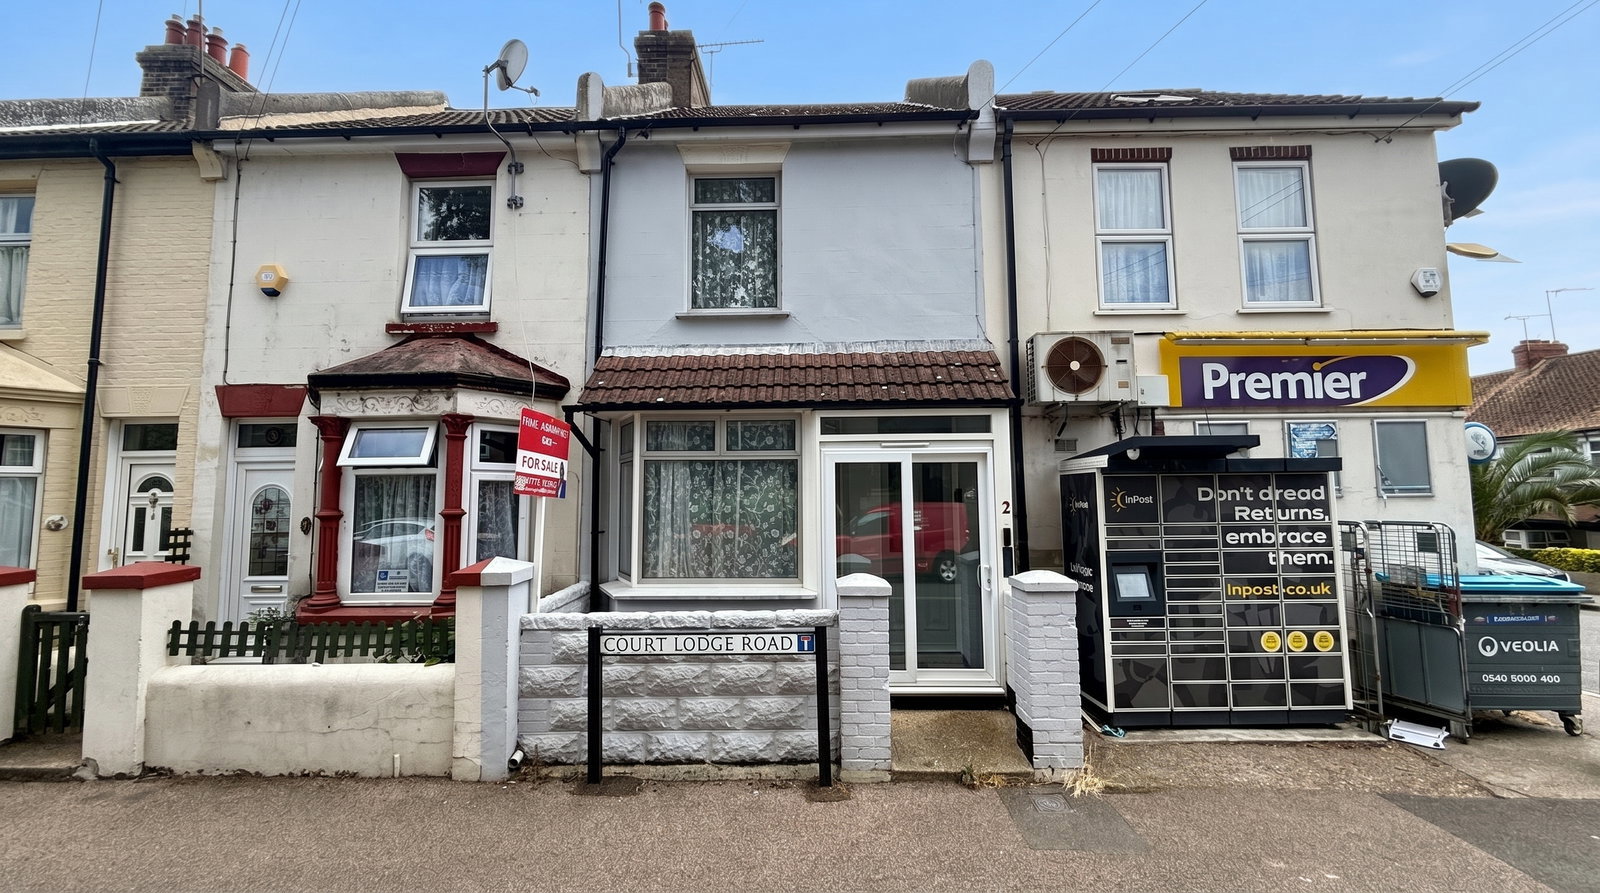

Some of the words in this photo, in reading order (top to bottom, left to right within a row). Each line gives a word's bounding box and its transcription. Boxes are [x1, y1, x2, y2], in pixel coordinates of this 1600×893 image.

[1202, 361, 1367, 400] Premier
[522, 455, 540, 470] FOR
[541, 459, 558, 473] SALE
[1125, 495, 1153, 504] InPost
[1197, 487, 1254, 501] Don't
[1259, 486, 1325, 500] dread
[1001, 500, 1011, 514] 2
[1234, 506, 1329, 522] Returns,
[1225, 528, 1327, 544] embrace
[1268, 551, 1333, 565] them.
[603, 637, 667, 652] COURT
[673, 636, 734, 652] LODGE
[741, 636, 793, 651] ROAD
[1500, 640, 1560, 652] VEOLIA
[1510, 674, 1537, 683] 5000
[1540, 675, 1561, 683] 400
